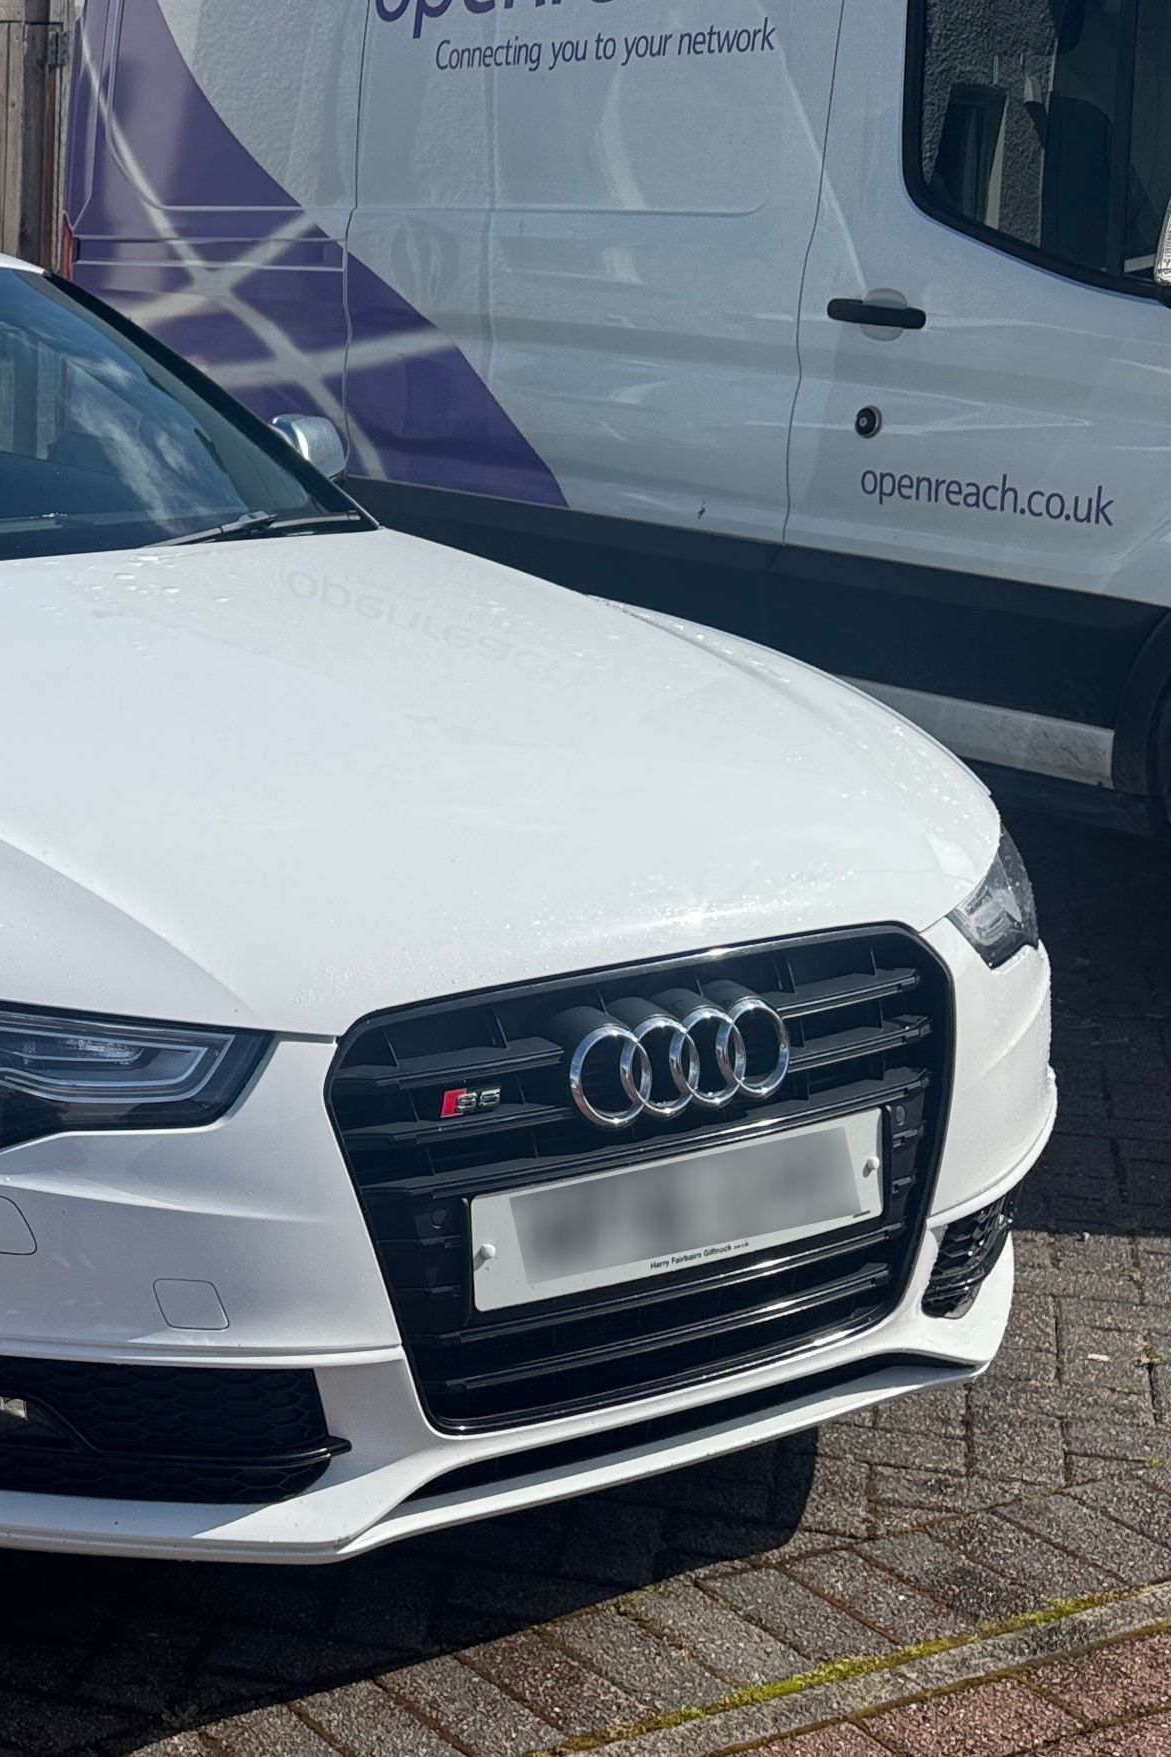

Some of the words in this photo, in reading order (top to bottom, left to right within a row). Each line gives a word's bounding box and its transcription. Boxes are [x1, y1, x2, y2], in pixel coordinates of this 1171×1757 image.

[435, 36, 541, 71] Connecting
[549, 36, 588, 70] you
[594, 32, 616, 61] to
[621, 31, 673, 65] your
[677, 16, 775, 56] network
[860, 470, 1114, 527] openreach.co.uk
[455, 1088, 501, 1112] S5
[650, 1260, 670, 1270] Harry
